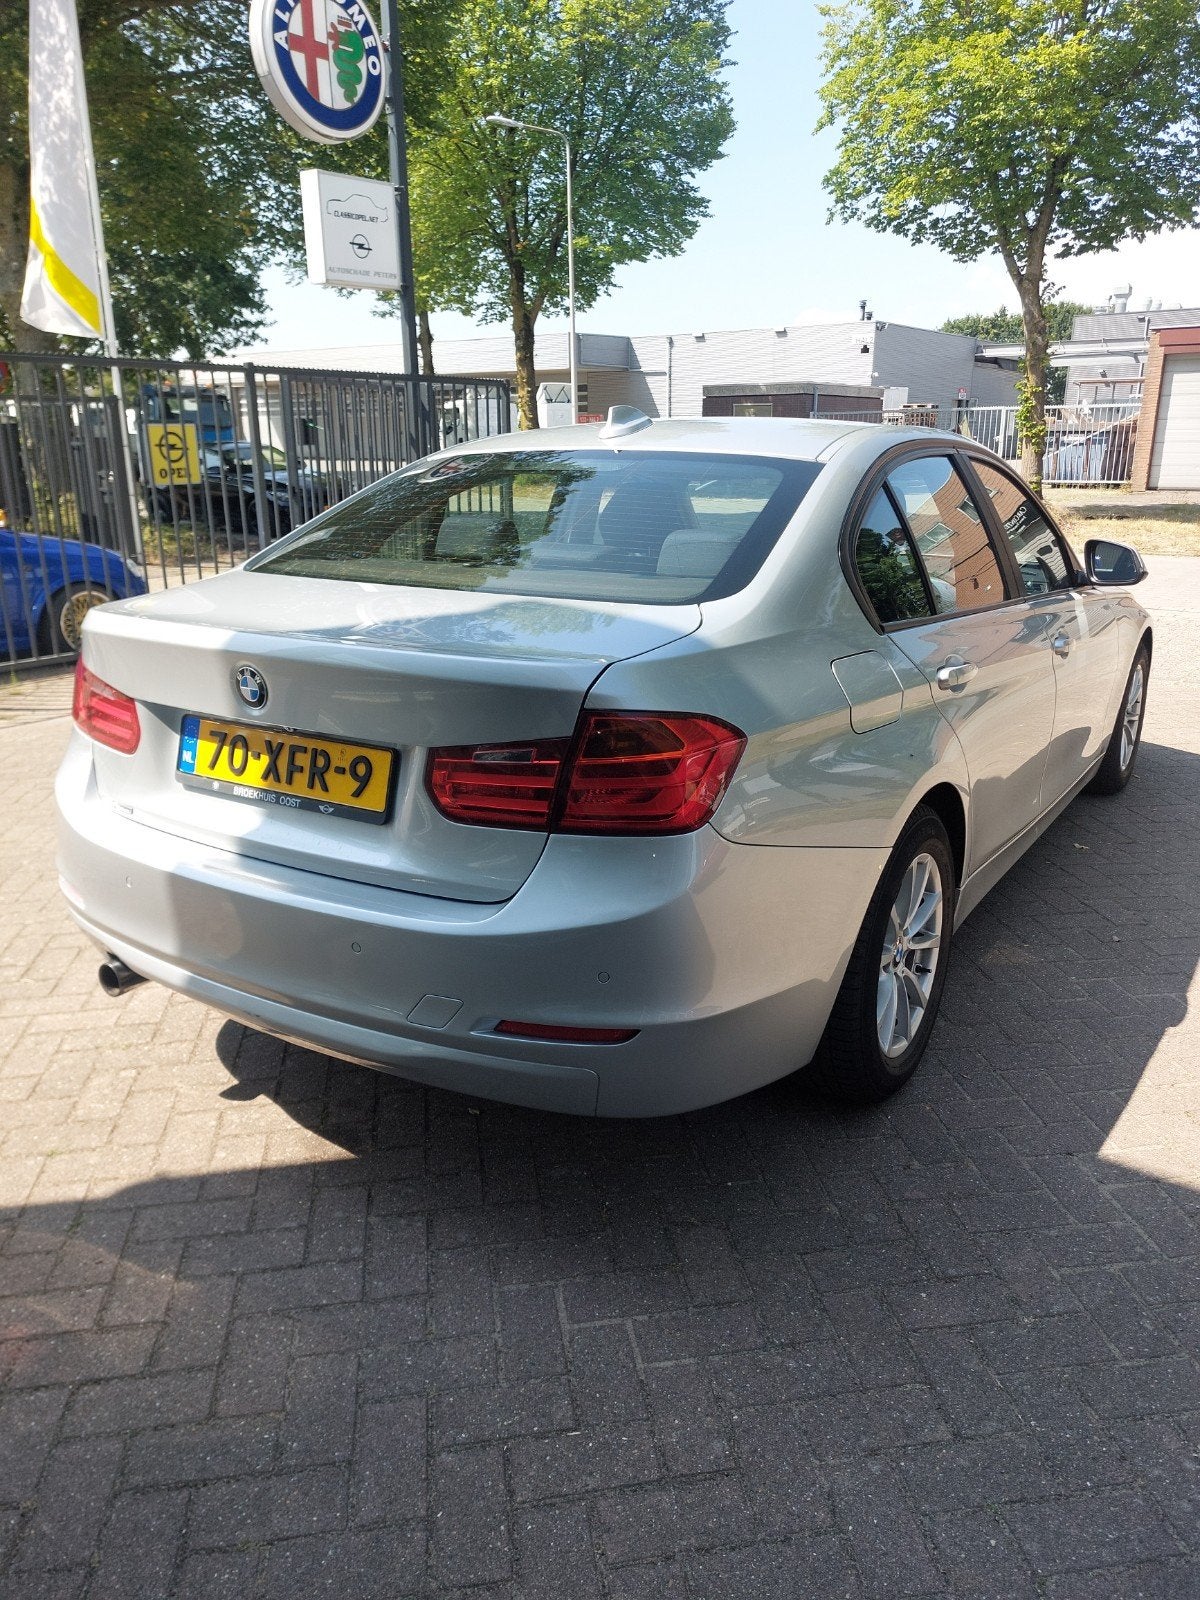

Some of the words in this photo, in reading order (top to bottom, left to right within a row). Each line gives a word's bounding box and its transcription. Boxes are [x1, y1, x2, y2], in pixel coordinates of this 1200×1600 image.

[236, 668, 262, 684] BMW
[182, 749, 195, 764] NL
[207, 730, 373, 798] 70-XFR-9
[233, 786, 276, 803] BROEKHUIS
[279, 795, 301, 808] OOST
